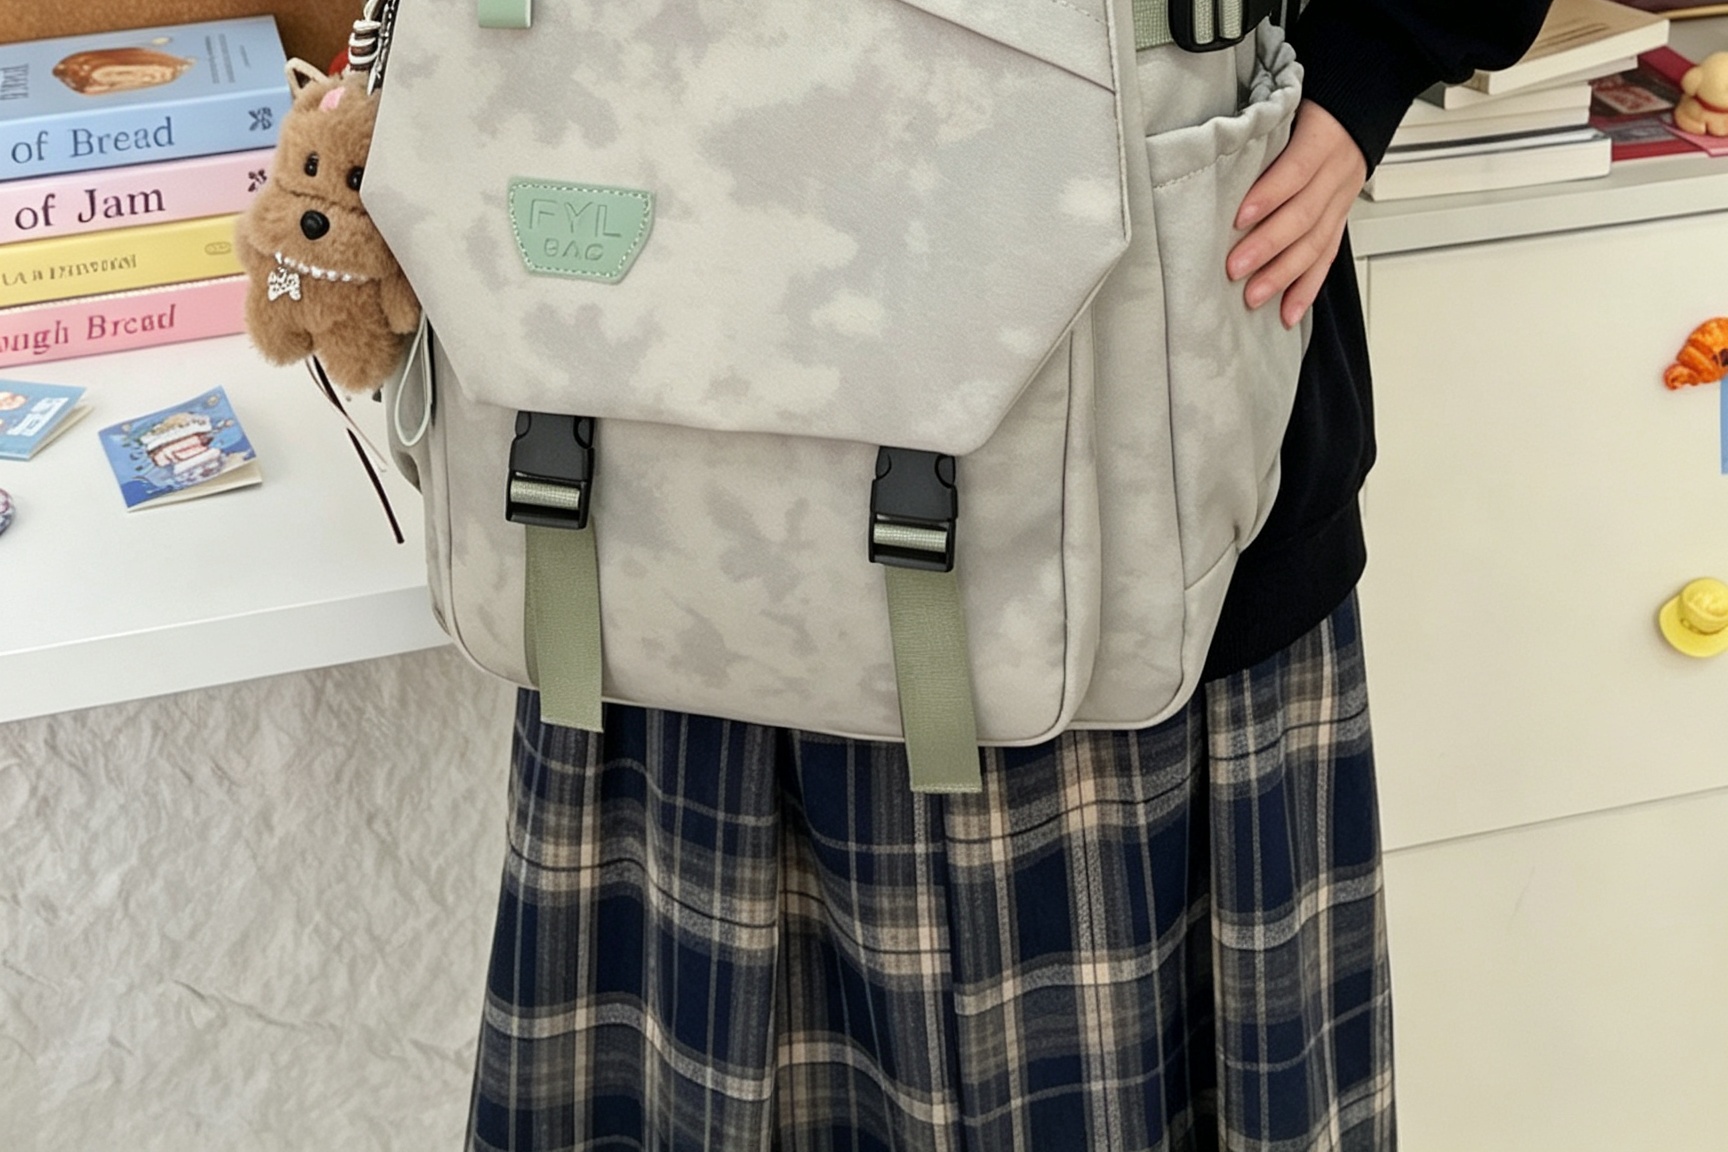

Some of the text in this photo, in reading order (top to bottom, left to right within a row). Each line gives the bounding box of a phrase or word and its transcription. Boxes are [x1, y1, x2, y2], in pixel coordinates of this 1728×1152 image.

[11, 115, 175, 164] of Bread
[14, 188, 166, 230] of Jam
[528, 198, 623, 238] FYL
[86, 303, 176, 341] Bread
